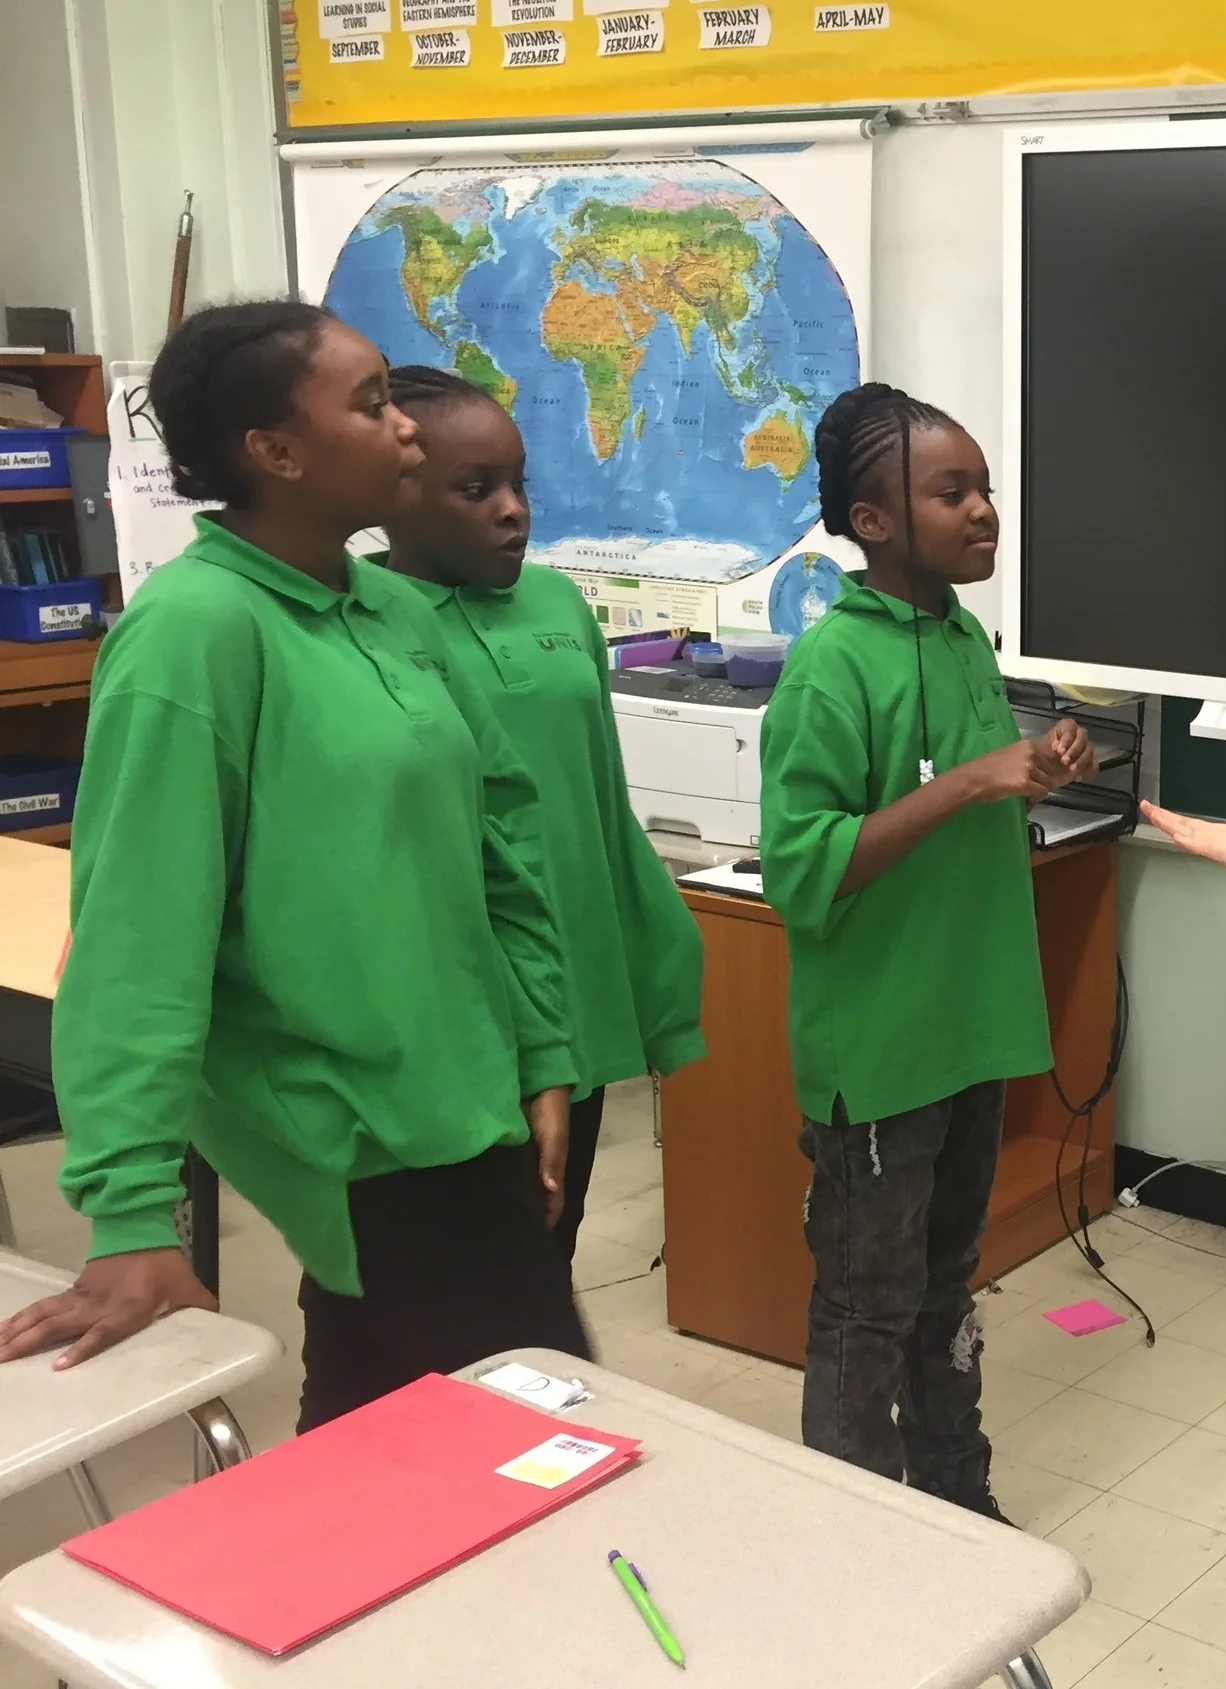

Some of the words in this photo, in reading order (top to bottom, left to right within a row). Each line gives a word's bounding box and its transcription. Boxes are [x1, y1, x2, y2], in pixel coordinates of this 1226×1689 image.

[323, 4, 355, 17] LEARNING
[355, 4, 363, 14] IN
[364, 1, 386, 13] SOCIAL
[402, 8, 432, 21] EASTERN
[433, 5, 475, 19] HEMISPHERE
[511, 6, 555, 21] REVOLUTION
[342, 17, 368, 30] STUDIES
[602, 14, 655, 35] JANUARY-
[703, 8, 760, 28] FEBRUARY
[815, 7, 884, 29] APRIL-MAY
[415, 32, 460, 49] OCTOBER-
[505, 30, 562, 48] NOVEMBER-
[605, 33, 659, 53] FEBRUARY
[714, 28, 756, 46] MARCH
[332, 41, 381, 58] SEPTEMBER
[414, 50, 466, 66] NOVEMBER
[509, 49, 559, 65] DECEMBER
[1020, 136, 1045, 146] SMART
[479, 300, 520, 311] Atlantic
[793, 318, 825, 329] Pacific
[803, 366, 831, 377] Ocean
[672, 379, 700, 389] Indian
[532, 395, 561, 406] Ocean
[672, 417, 700, 426] Ocean
[750, 444, 793, 453] AUSTRALIA
[13, 454, 49, 466] America
[133, 482, 153, 494] and
[576, 549, 638, 561] ANTARCTICA
[50, 607, 66, 618] The
[67, 605, 80, 616] US
[2, 801, 17, 812] The
